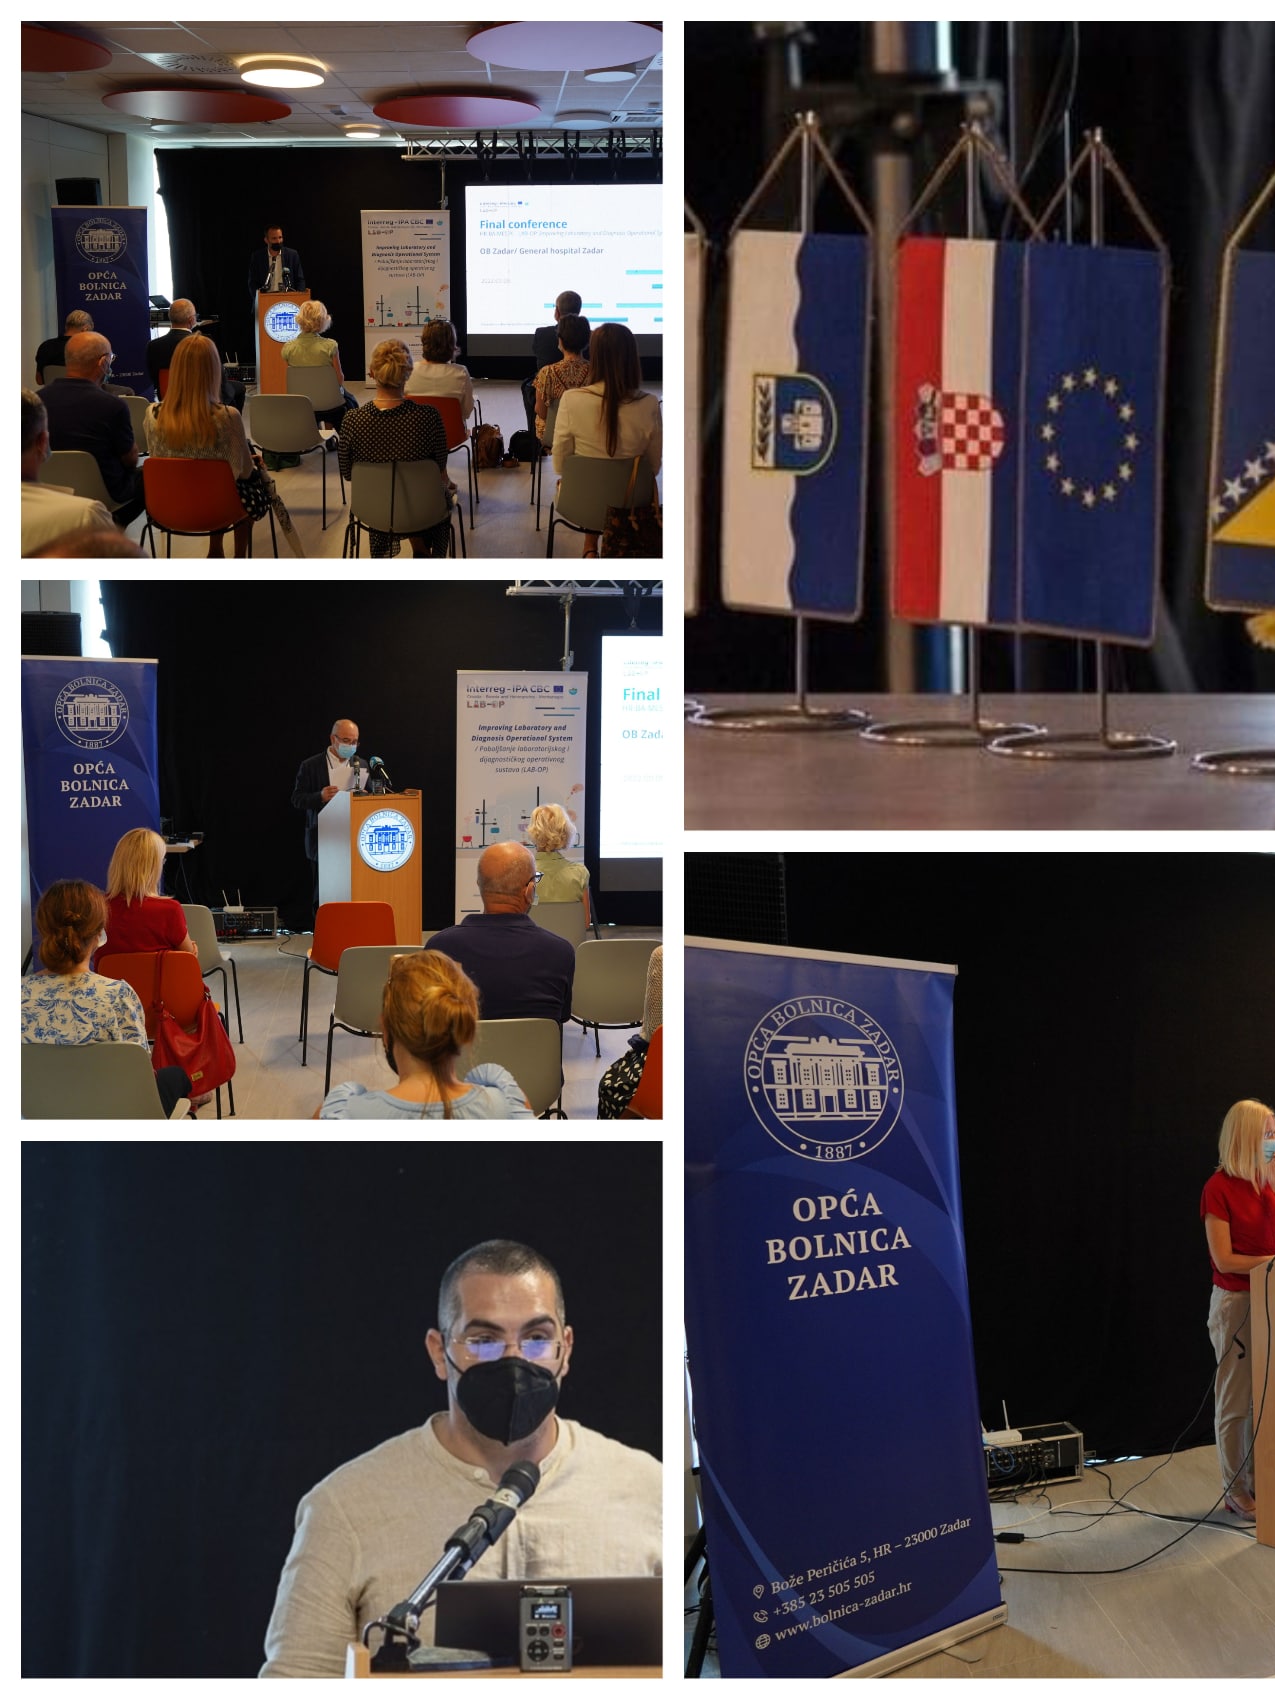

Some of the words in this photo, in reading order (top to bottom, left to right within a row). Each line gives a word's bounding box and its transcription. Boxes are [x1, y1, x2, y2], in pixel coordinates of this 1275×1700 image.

[479, 220, 505, 229] Final
[508, 219, 568, 229] conference
[492, 247, 518, 255] Zadar/
[519, 247, 549, 255] General
[550, 247, 581, 256] hospital
[88, 270, 117, 280] OPĆA
[79, 281, 127, 291] BOLNICA
[85, 292, 122, 301] ZADAR
[530, 685, 550, 693] CBC
[623, 687, 660, 701] Final
[478, 724, 513, 732] Improving
[514, 724, 552, 732] Laboratory
[622, 730, 638, 739] OB
[471, 735, 504, 743] Diagnosis
[505, 735, 547, 743] Operational
[73, 761, 116, 775] OPĆA
[61, 779, 130, 792] BOLNICA
[69, 795, 122, 809] ZADAR
[770, 999, 856, 1027] BOLNICA
[862, 1018, 900, 1082] ZADAR
[815, 1144, 853, 1160] 1887
[792, 1188, 883, 1222] OPĆA
[765, 1226, 912, 1265] BOLNICA
[787, 1264, 899, 1300] ZADAR
[771, 1574, 804, 1595] Bože
[806, 1554, 858, 1582] Peričića
[860, 1550, 872, 1564] 5,
[873, 1543, 893, 1560] HR
[904, 1527, 939, 1549] 23000
[939, 1516, 972, 1536] Zadar
[773, 1596, 806, 1616] +385
[809, 1589, 826, 1605] 23
[828, 1579, 851, 1598] 505
[853, 1570, 876, 1589] 505
[775, 1580, 913, 1641] www.bolnica-zadar.hr
